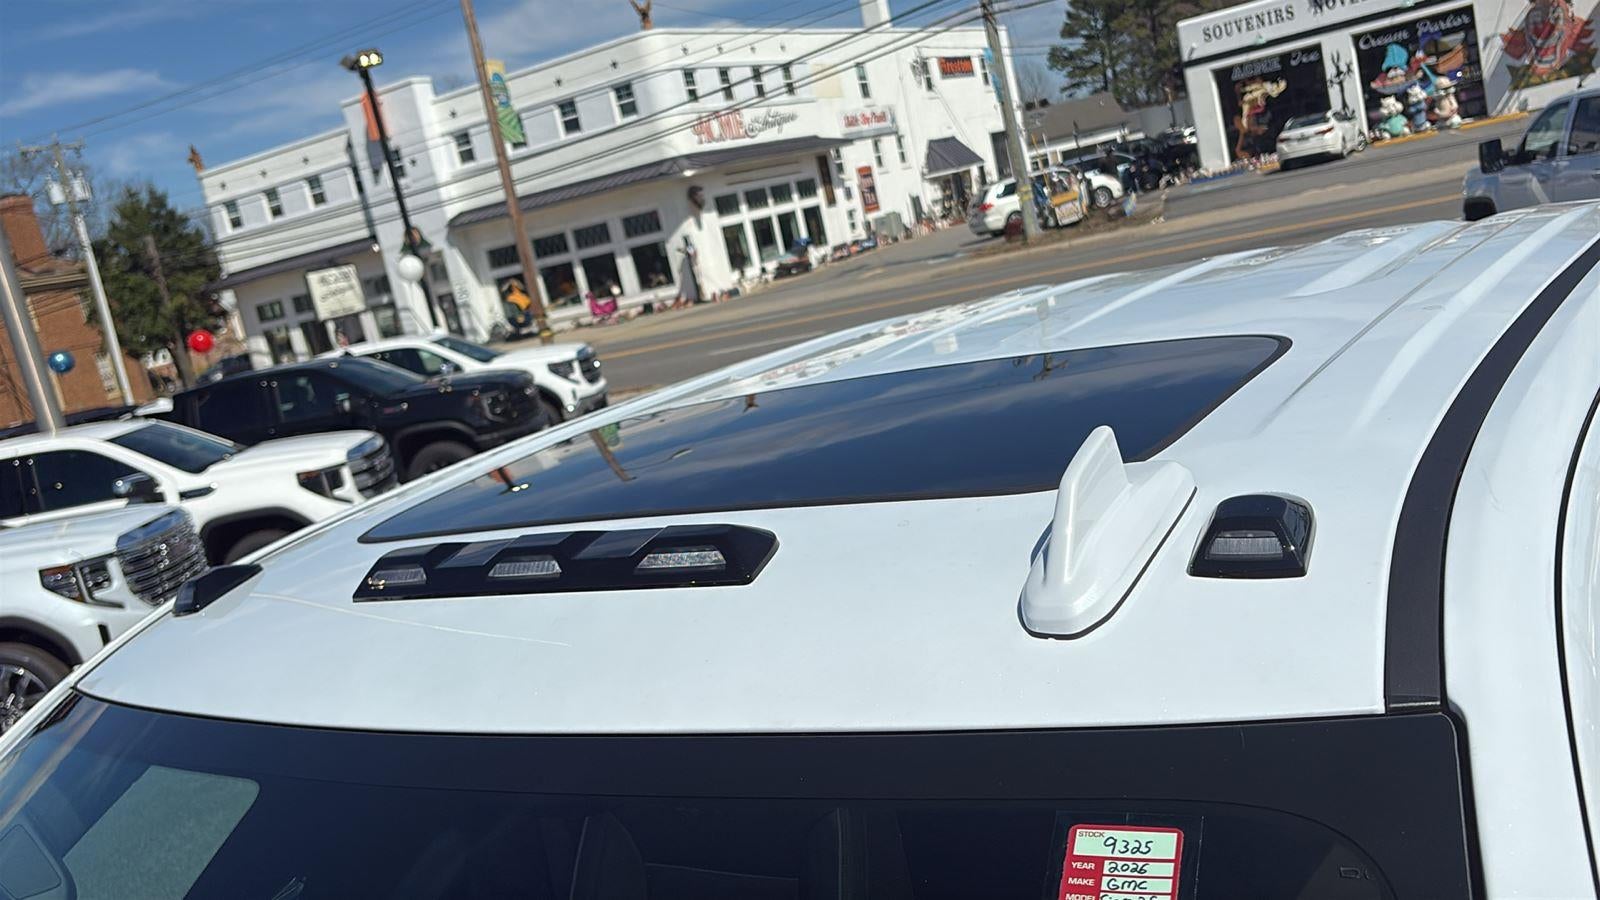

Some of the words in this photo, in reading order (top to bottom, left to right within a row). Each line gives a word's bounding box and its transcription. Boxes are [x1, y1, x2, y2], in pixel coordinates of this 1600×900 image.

[1202, 5, 1295, 43] SOUVENIRS
[1103, 836, 1154, 855] 9325
[1071, 861, 1095, 870] YEAR
[1108, 861, 1149, 874] 2026
[1068, 877, 1095, 887] MAKE
